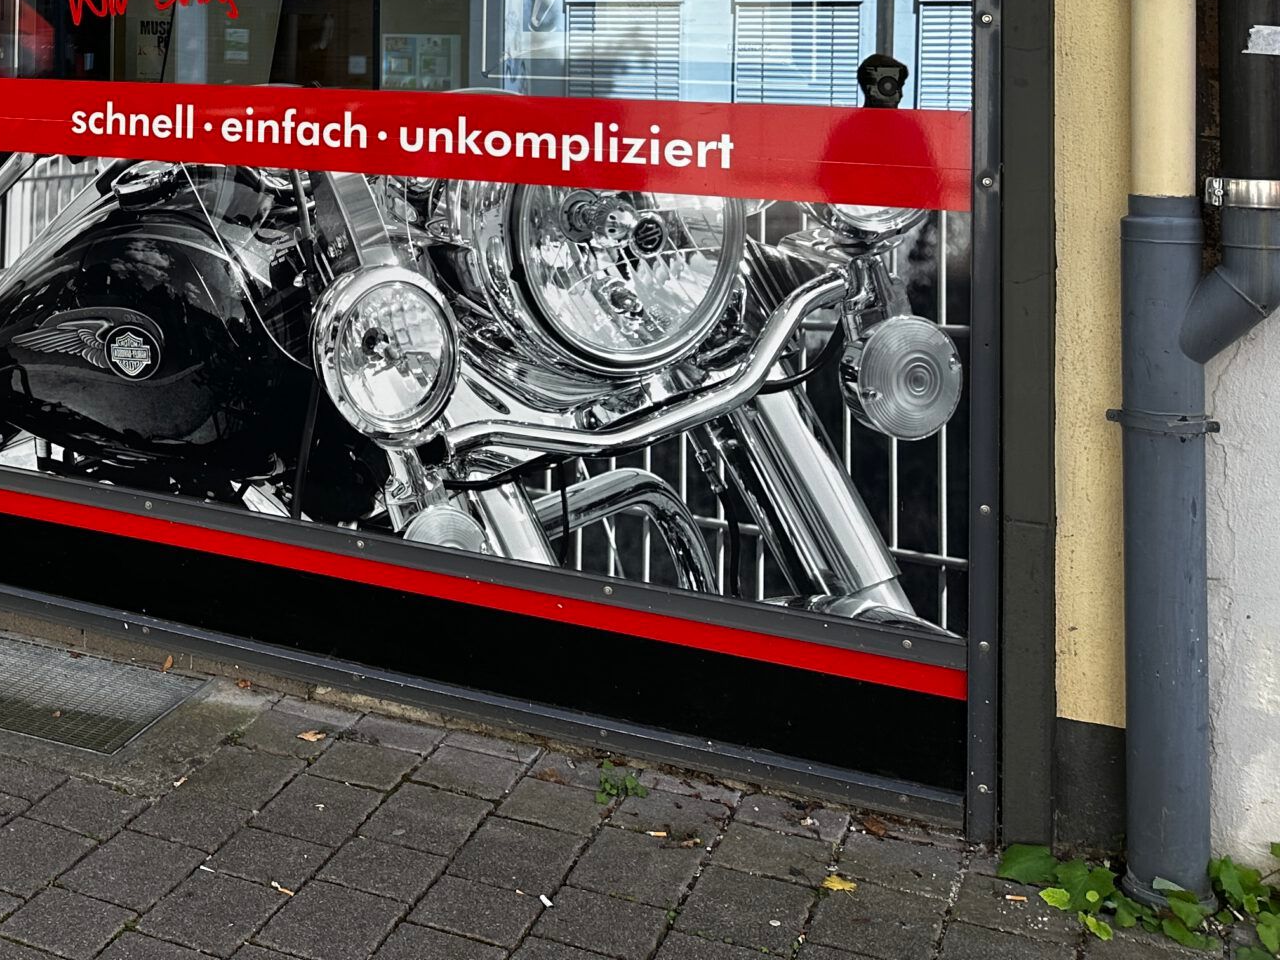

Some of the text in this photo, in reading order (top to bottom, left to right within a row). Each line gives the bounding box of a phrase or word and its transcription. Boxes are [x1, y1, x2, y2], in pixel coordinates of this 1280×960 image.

[70, 100, 736, 171] schnell einfach unkompliziert
